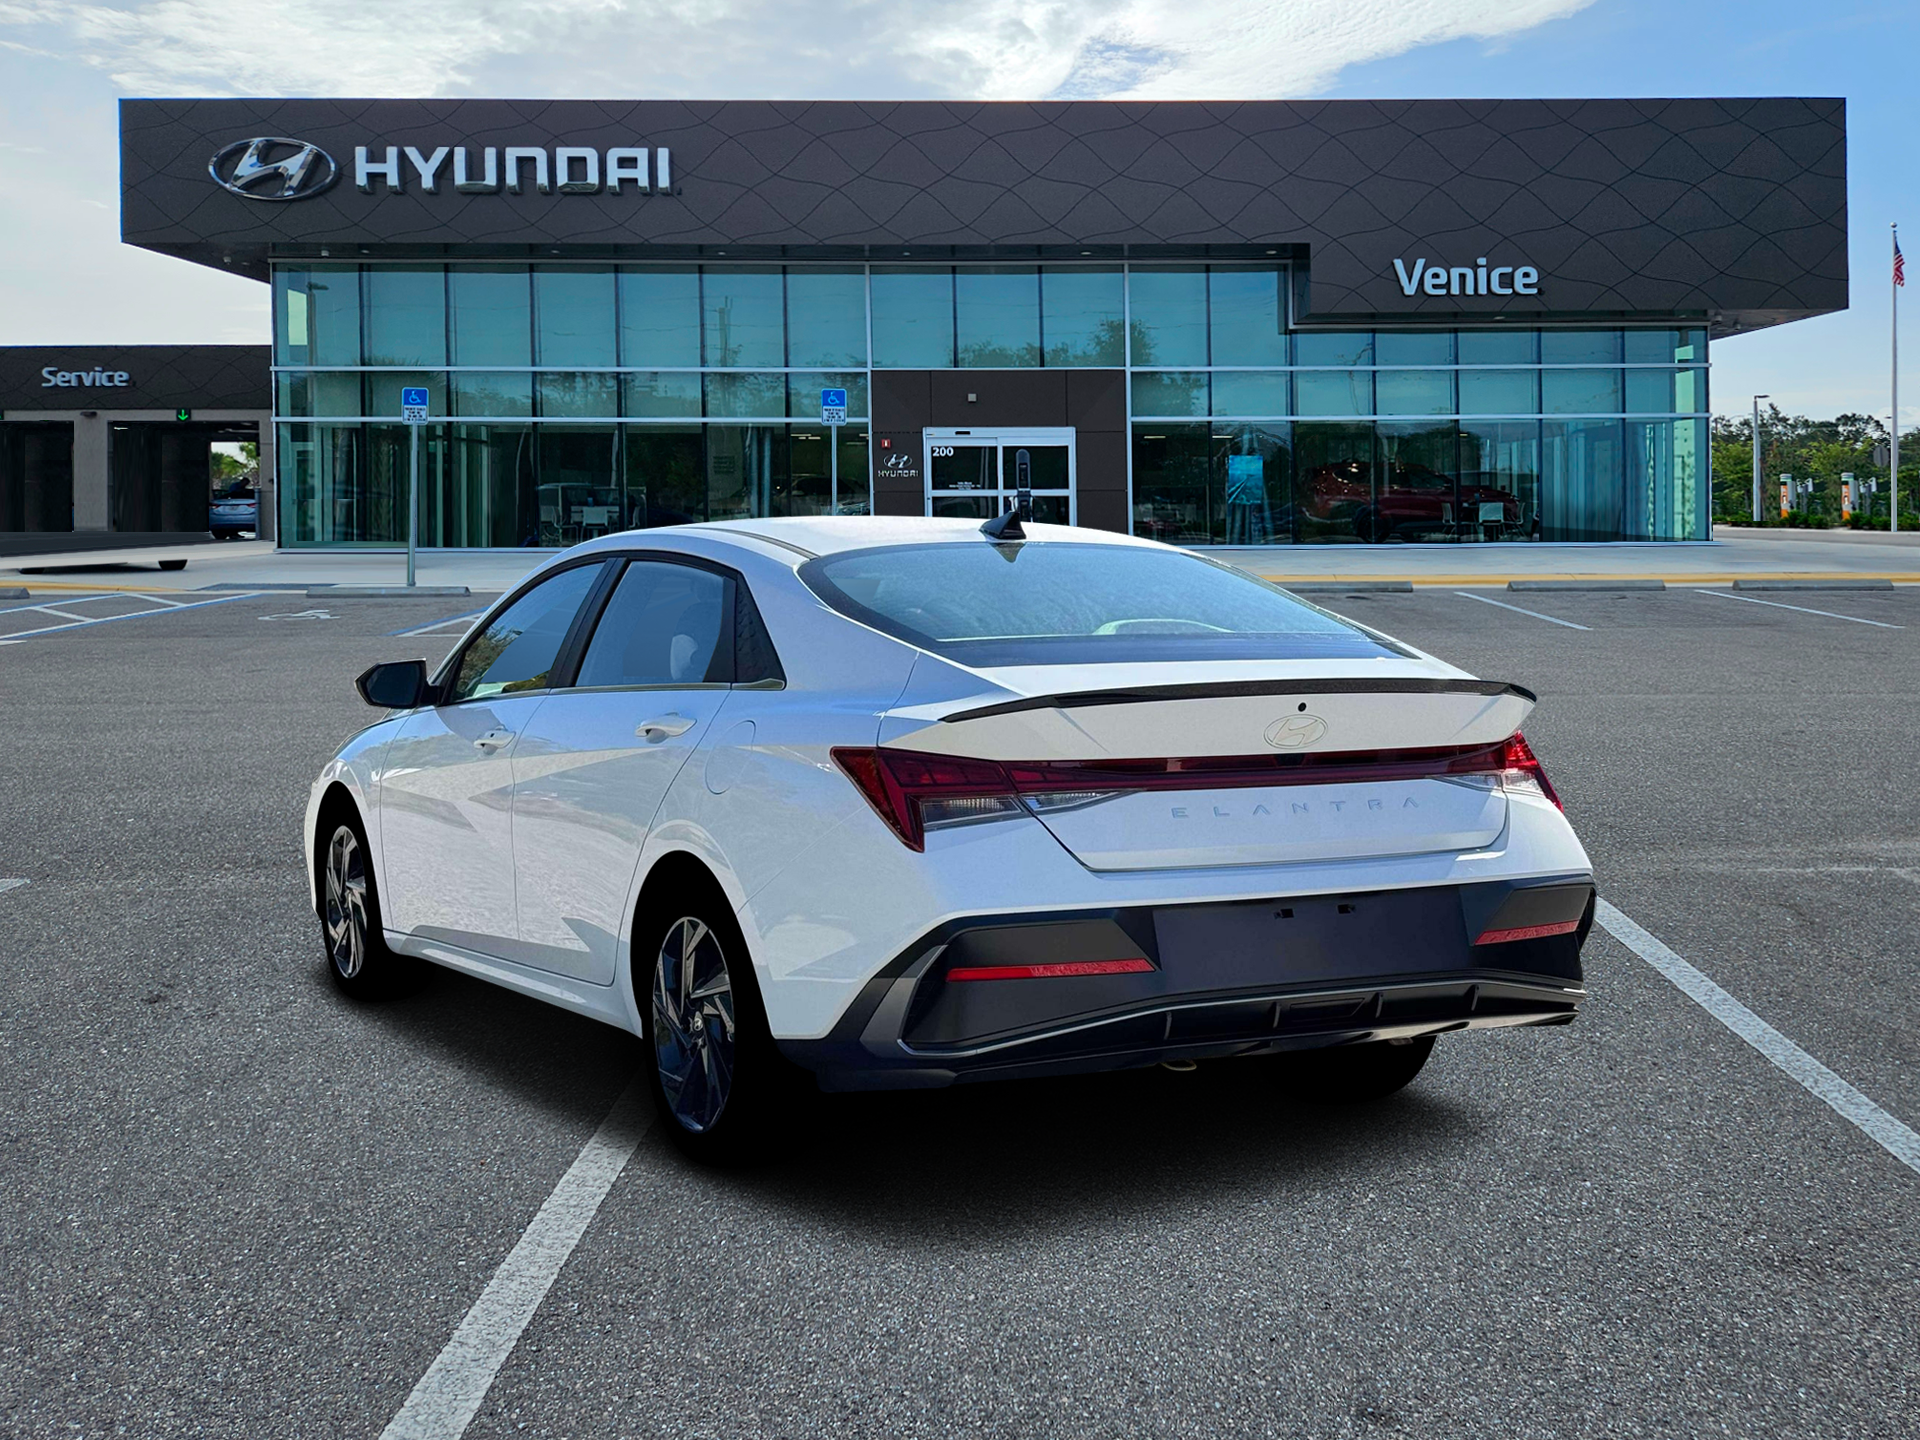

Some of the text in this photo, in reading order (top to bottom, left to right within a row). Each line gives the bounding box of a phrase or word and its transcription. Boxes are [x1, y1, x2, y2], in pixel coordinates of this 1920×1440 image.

[354, 146, 671, 194] HYUNDAI
[1392, 257, 1539, 296] Venice
[41, 366, 130, 387] Service
[932, 446, 954, 457] 200
[878, 470, 919, 478] HYUNDAI
[1171, 797, 1420, 818] ELANTRA
